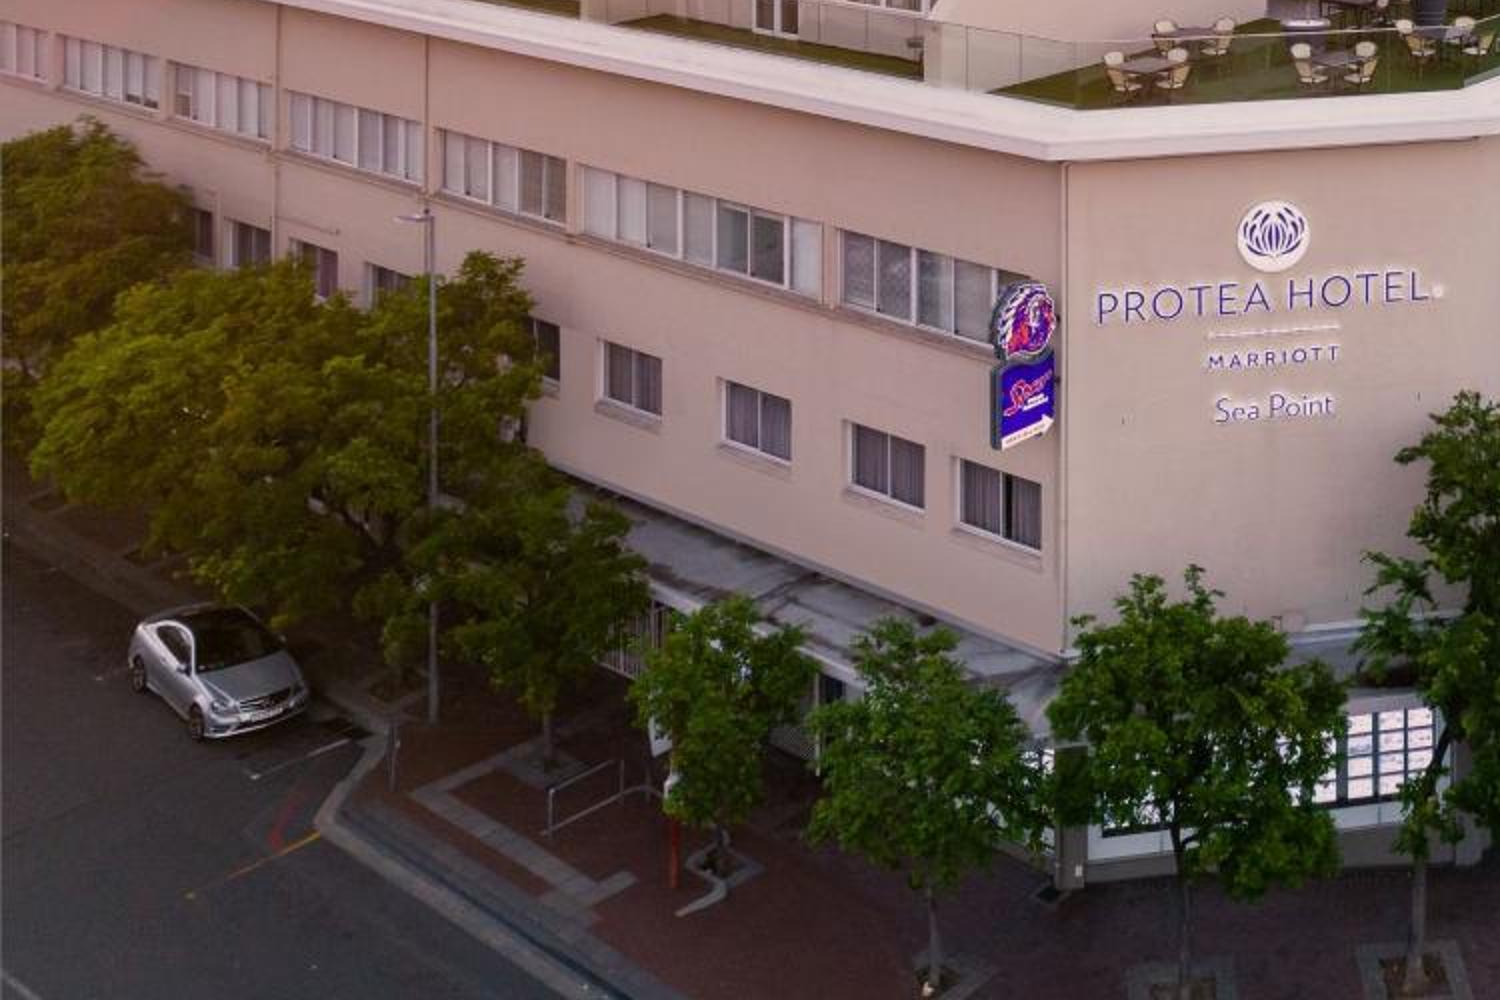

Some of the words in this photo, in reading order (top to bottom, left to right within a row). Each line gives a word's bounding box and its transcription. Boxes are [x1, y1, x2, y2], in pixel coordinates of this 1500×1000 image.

[1097, 283, 1271, 324] PROTEA
[1288, 271, 1430, 309] HOTEL
[1207, 345, 1340, 370] MARRIOTT
[1214, 397, 1260, 422] Sea
[1269, 392, 1334, 418] Point
